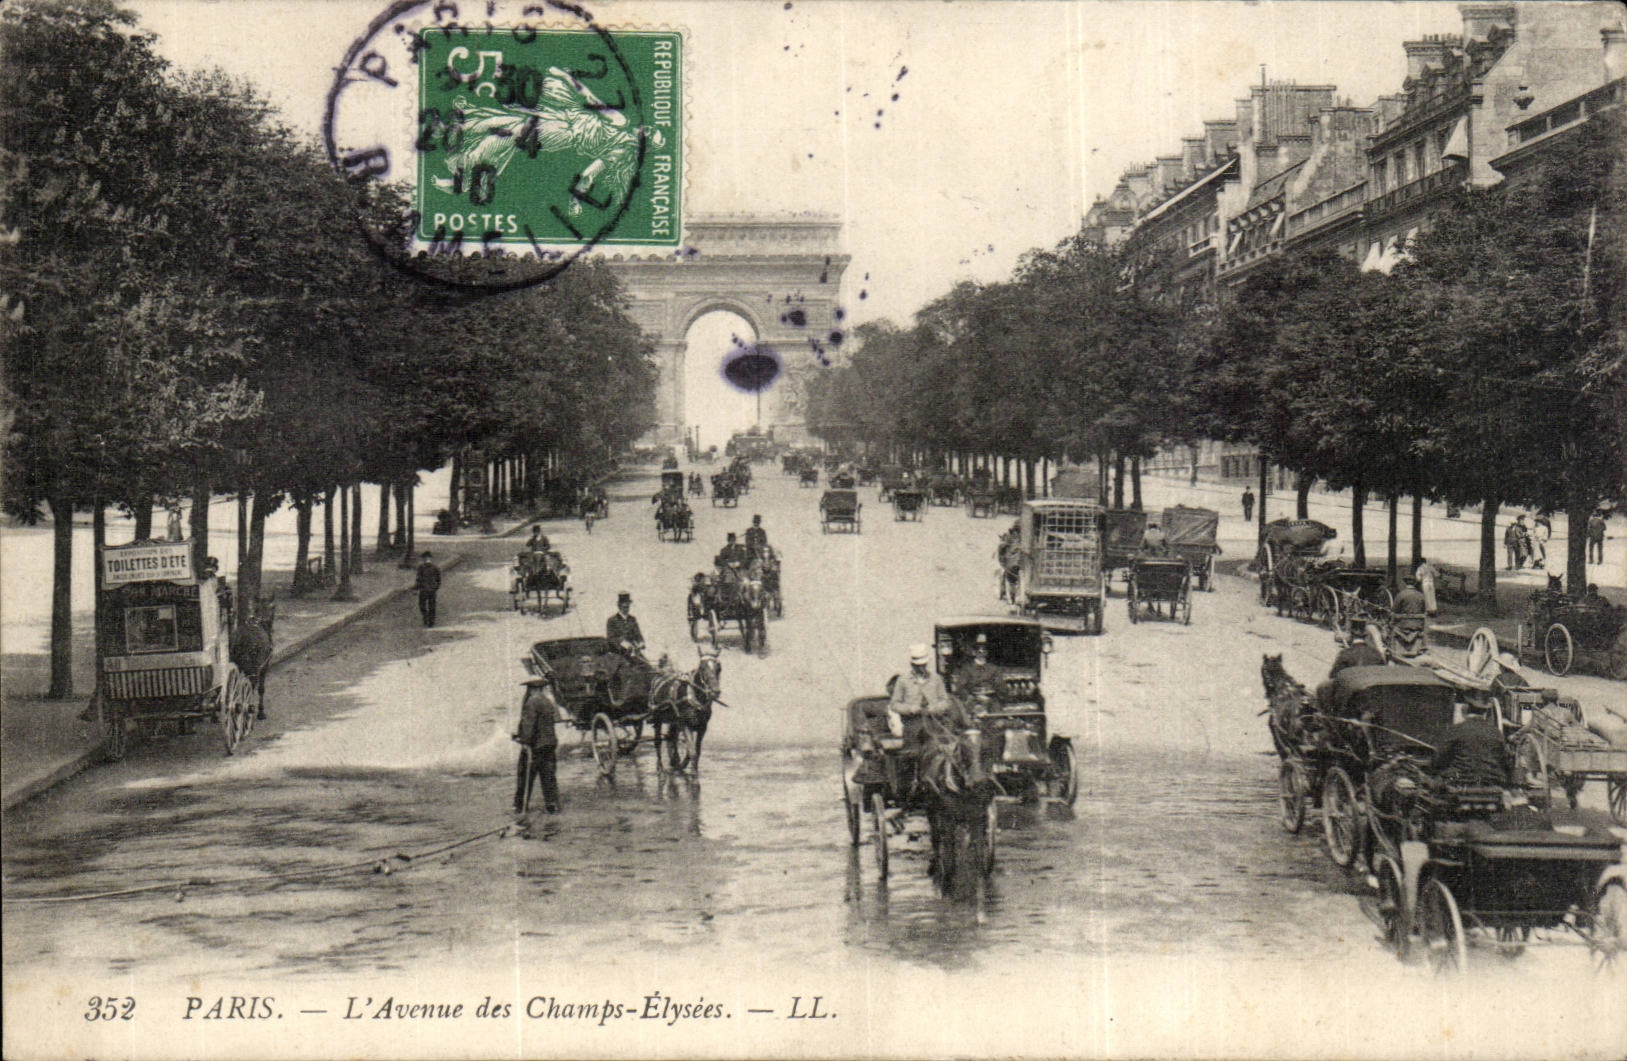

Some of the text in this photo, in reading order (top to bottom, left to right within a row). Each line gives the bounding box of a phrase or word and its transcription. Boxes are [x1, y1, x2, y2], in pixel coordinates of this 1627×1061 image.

[651, 154, 672, 237] FRANÇAISE
[433, 212, 519, 234] POSTES
[107, 556, 159, 573] TOILETTES
